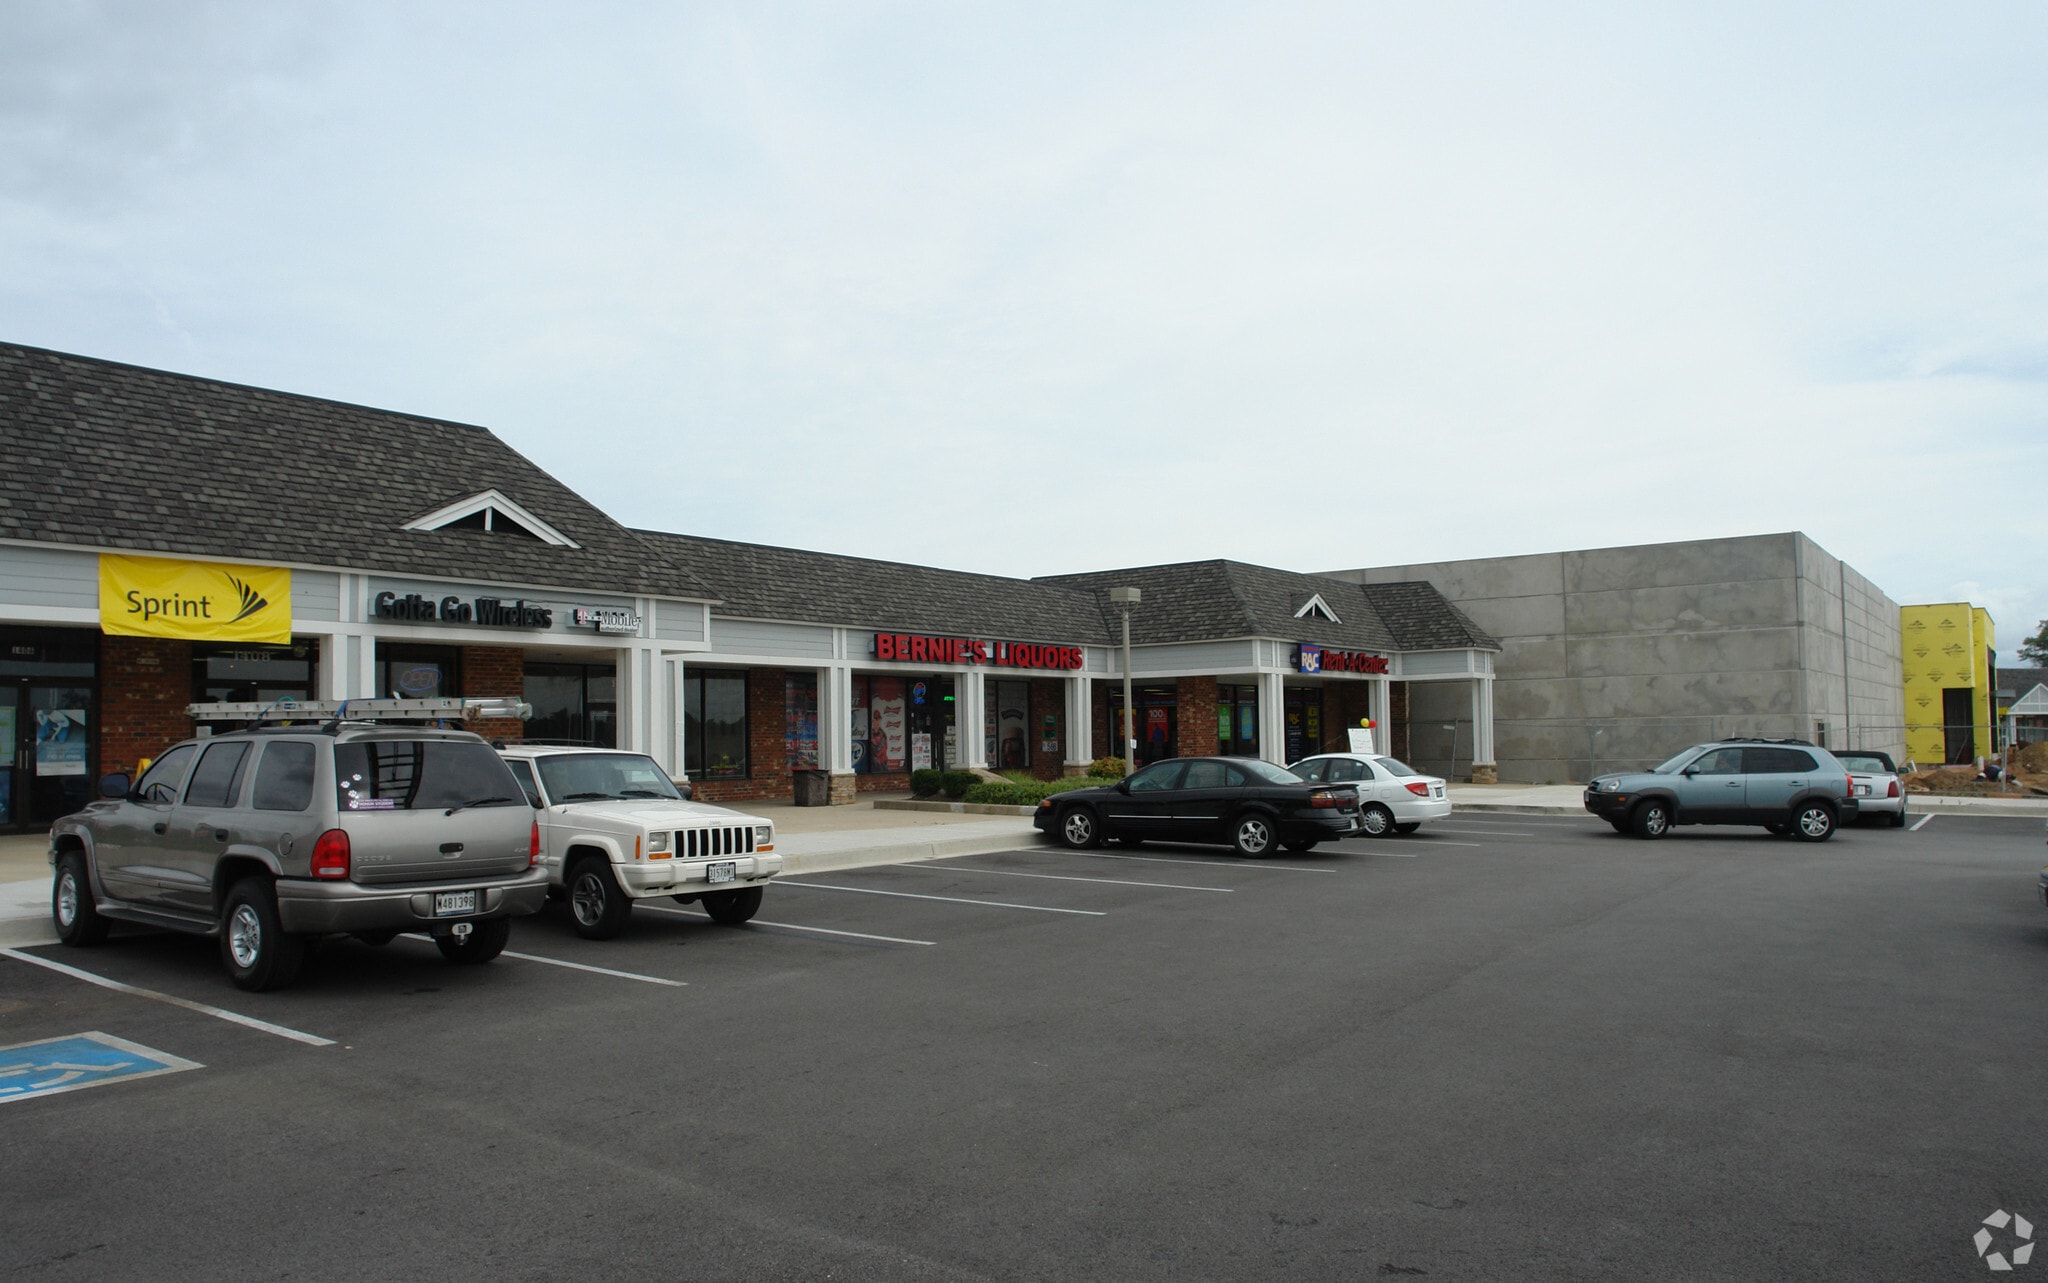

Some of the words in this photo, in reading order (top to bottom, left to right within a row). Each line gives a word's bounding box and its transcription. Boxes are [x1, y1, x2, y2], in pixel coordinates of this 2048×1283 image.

[126, 590, 211, 621] Sprint
[375, 591, 437, 622] Gotta
[440, 596, 473, 623] Go
[475, 598, 553, 629] Wireless
[233, 650, 271, 662] 1408
[876, 633, 987, 665] BERNIE'S
[995, 642, 1083, 670] LIQUORS
[1301, 652, 1319, 671] RAC
[401, 670, 437, 687] OPEN
